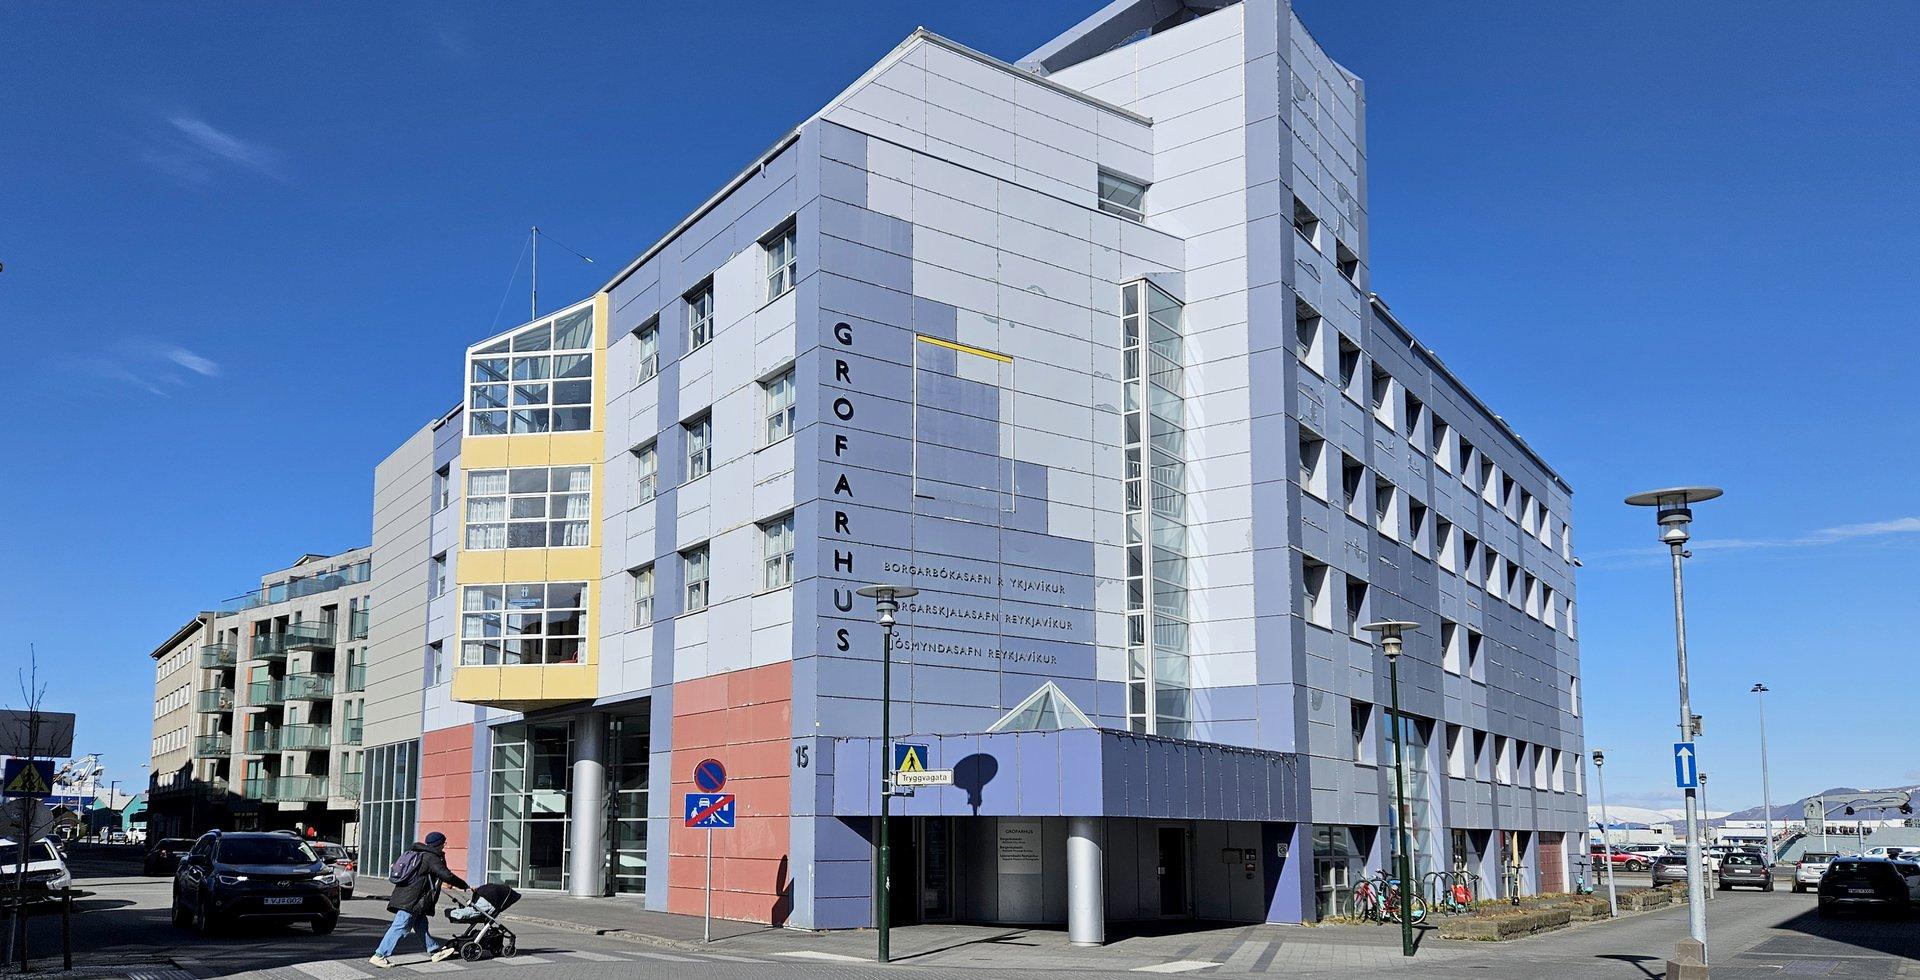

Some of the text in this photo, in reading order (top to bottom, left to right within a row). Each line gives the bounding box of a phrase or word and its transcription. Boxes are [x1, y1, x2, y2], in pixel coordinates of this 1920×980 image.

[884, 562, 992, 584] BORGARBÓKASAFN
[896, 602, 1073, 631] RGARSKJALASAFN REYKJAVÍKUR
[889, 638, 1057, 667] JÓSMYNDASAFN REYKJAVÍKUR
[796, 745, 809, 768] 15
[902, 774, 948, 783] Tryggvagata
